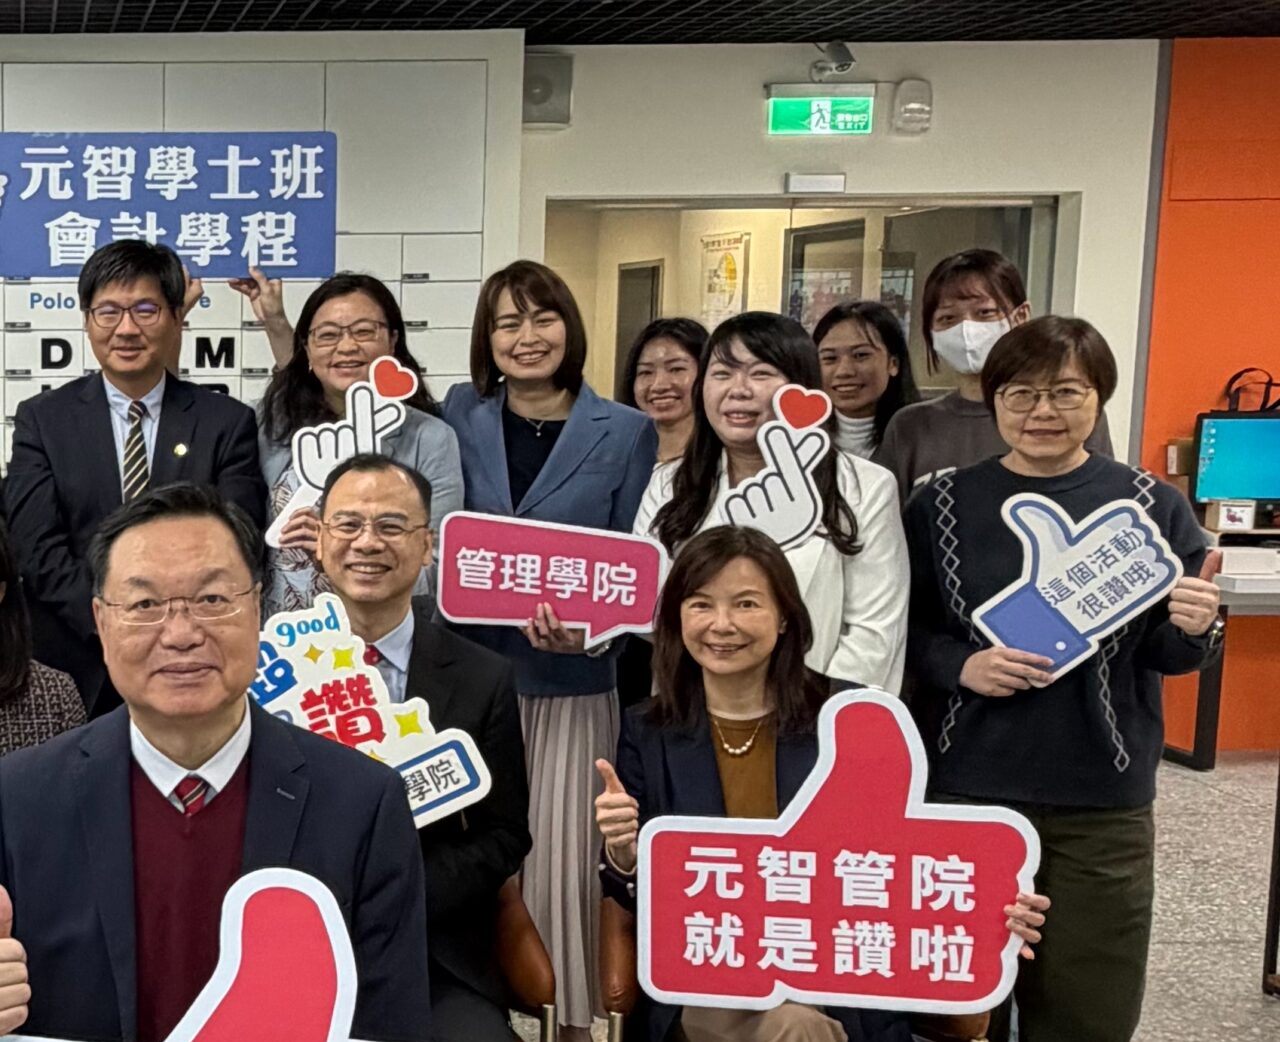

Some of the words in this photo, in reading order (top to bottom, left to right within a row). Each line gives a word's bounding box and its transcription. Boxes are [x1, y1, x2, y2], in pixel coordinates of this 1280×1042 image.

[20, 144, 324, 201] 元智學士班
[456, 546, 637, 606] 管理學院
[1041, 529, 1142, 605] 這個活動
[1076, 560, 1156, 620] 很讚哦
[276, 601, 341, 647] good
[683, 846, 976, 912] 元智管院
[683, 911, 976, 984] 就是讚啦
